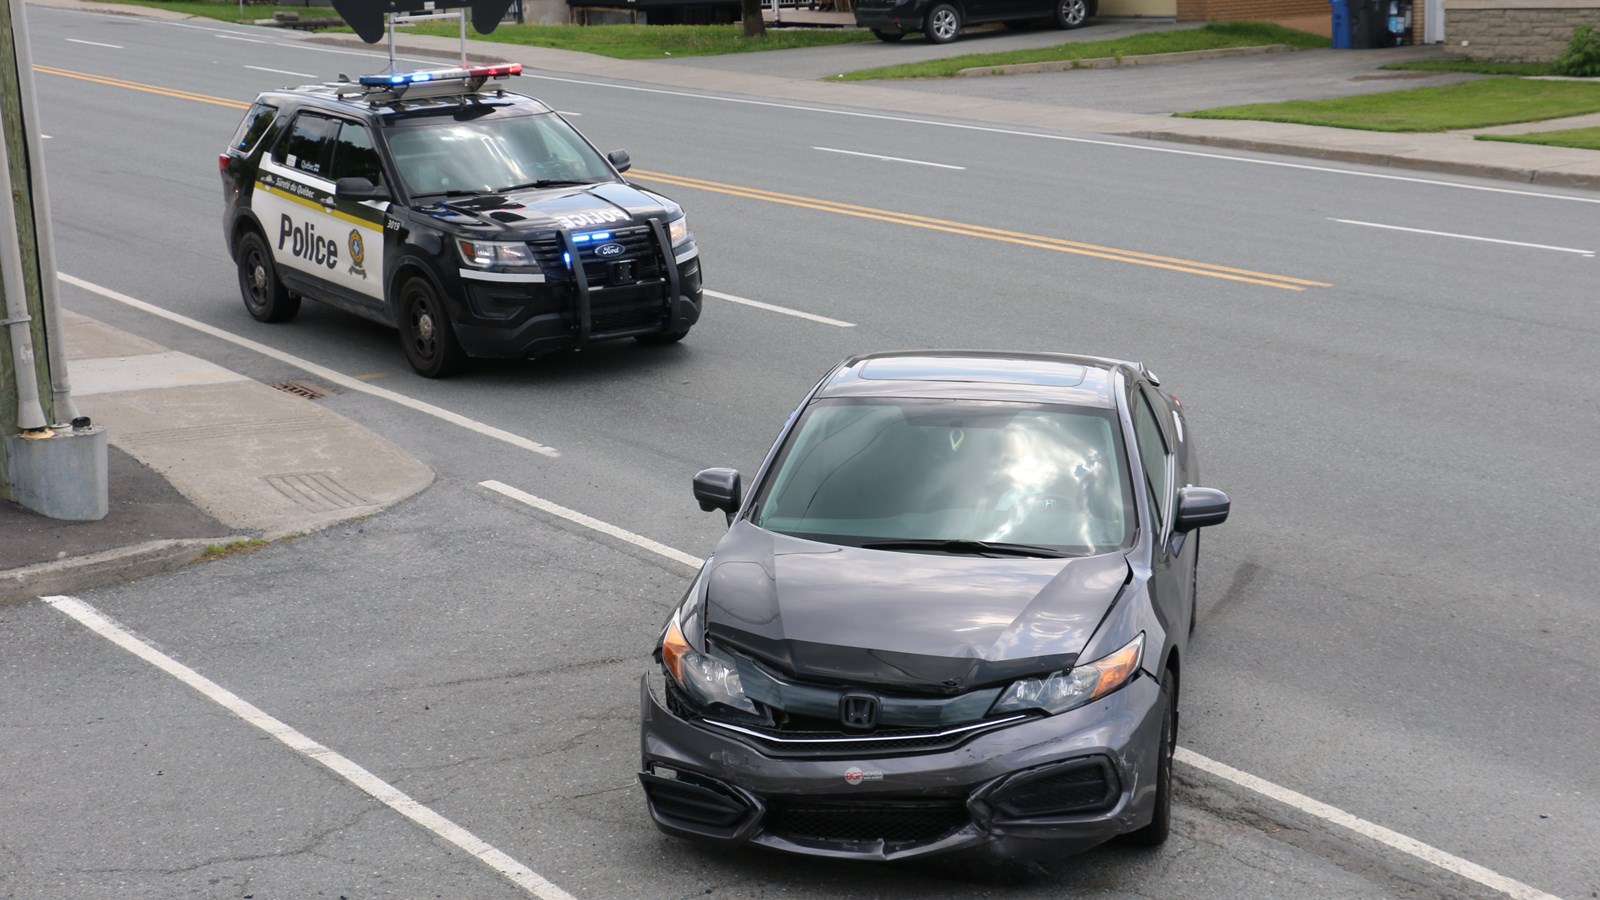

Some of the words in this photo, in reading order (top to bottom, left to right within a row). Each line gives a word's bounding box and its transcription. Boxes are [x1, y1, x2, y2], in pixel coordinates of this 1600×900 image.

[290, 182, 298, 192] du
[386, 219, 401, 231] 3019
[278, 213, 338, 269] Police
[602, 245, 621, 255] Ford
